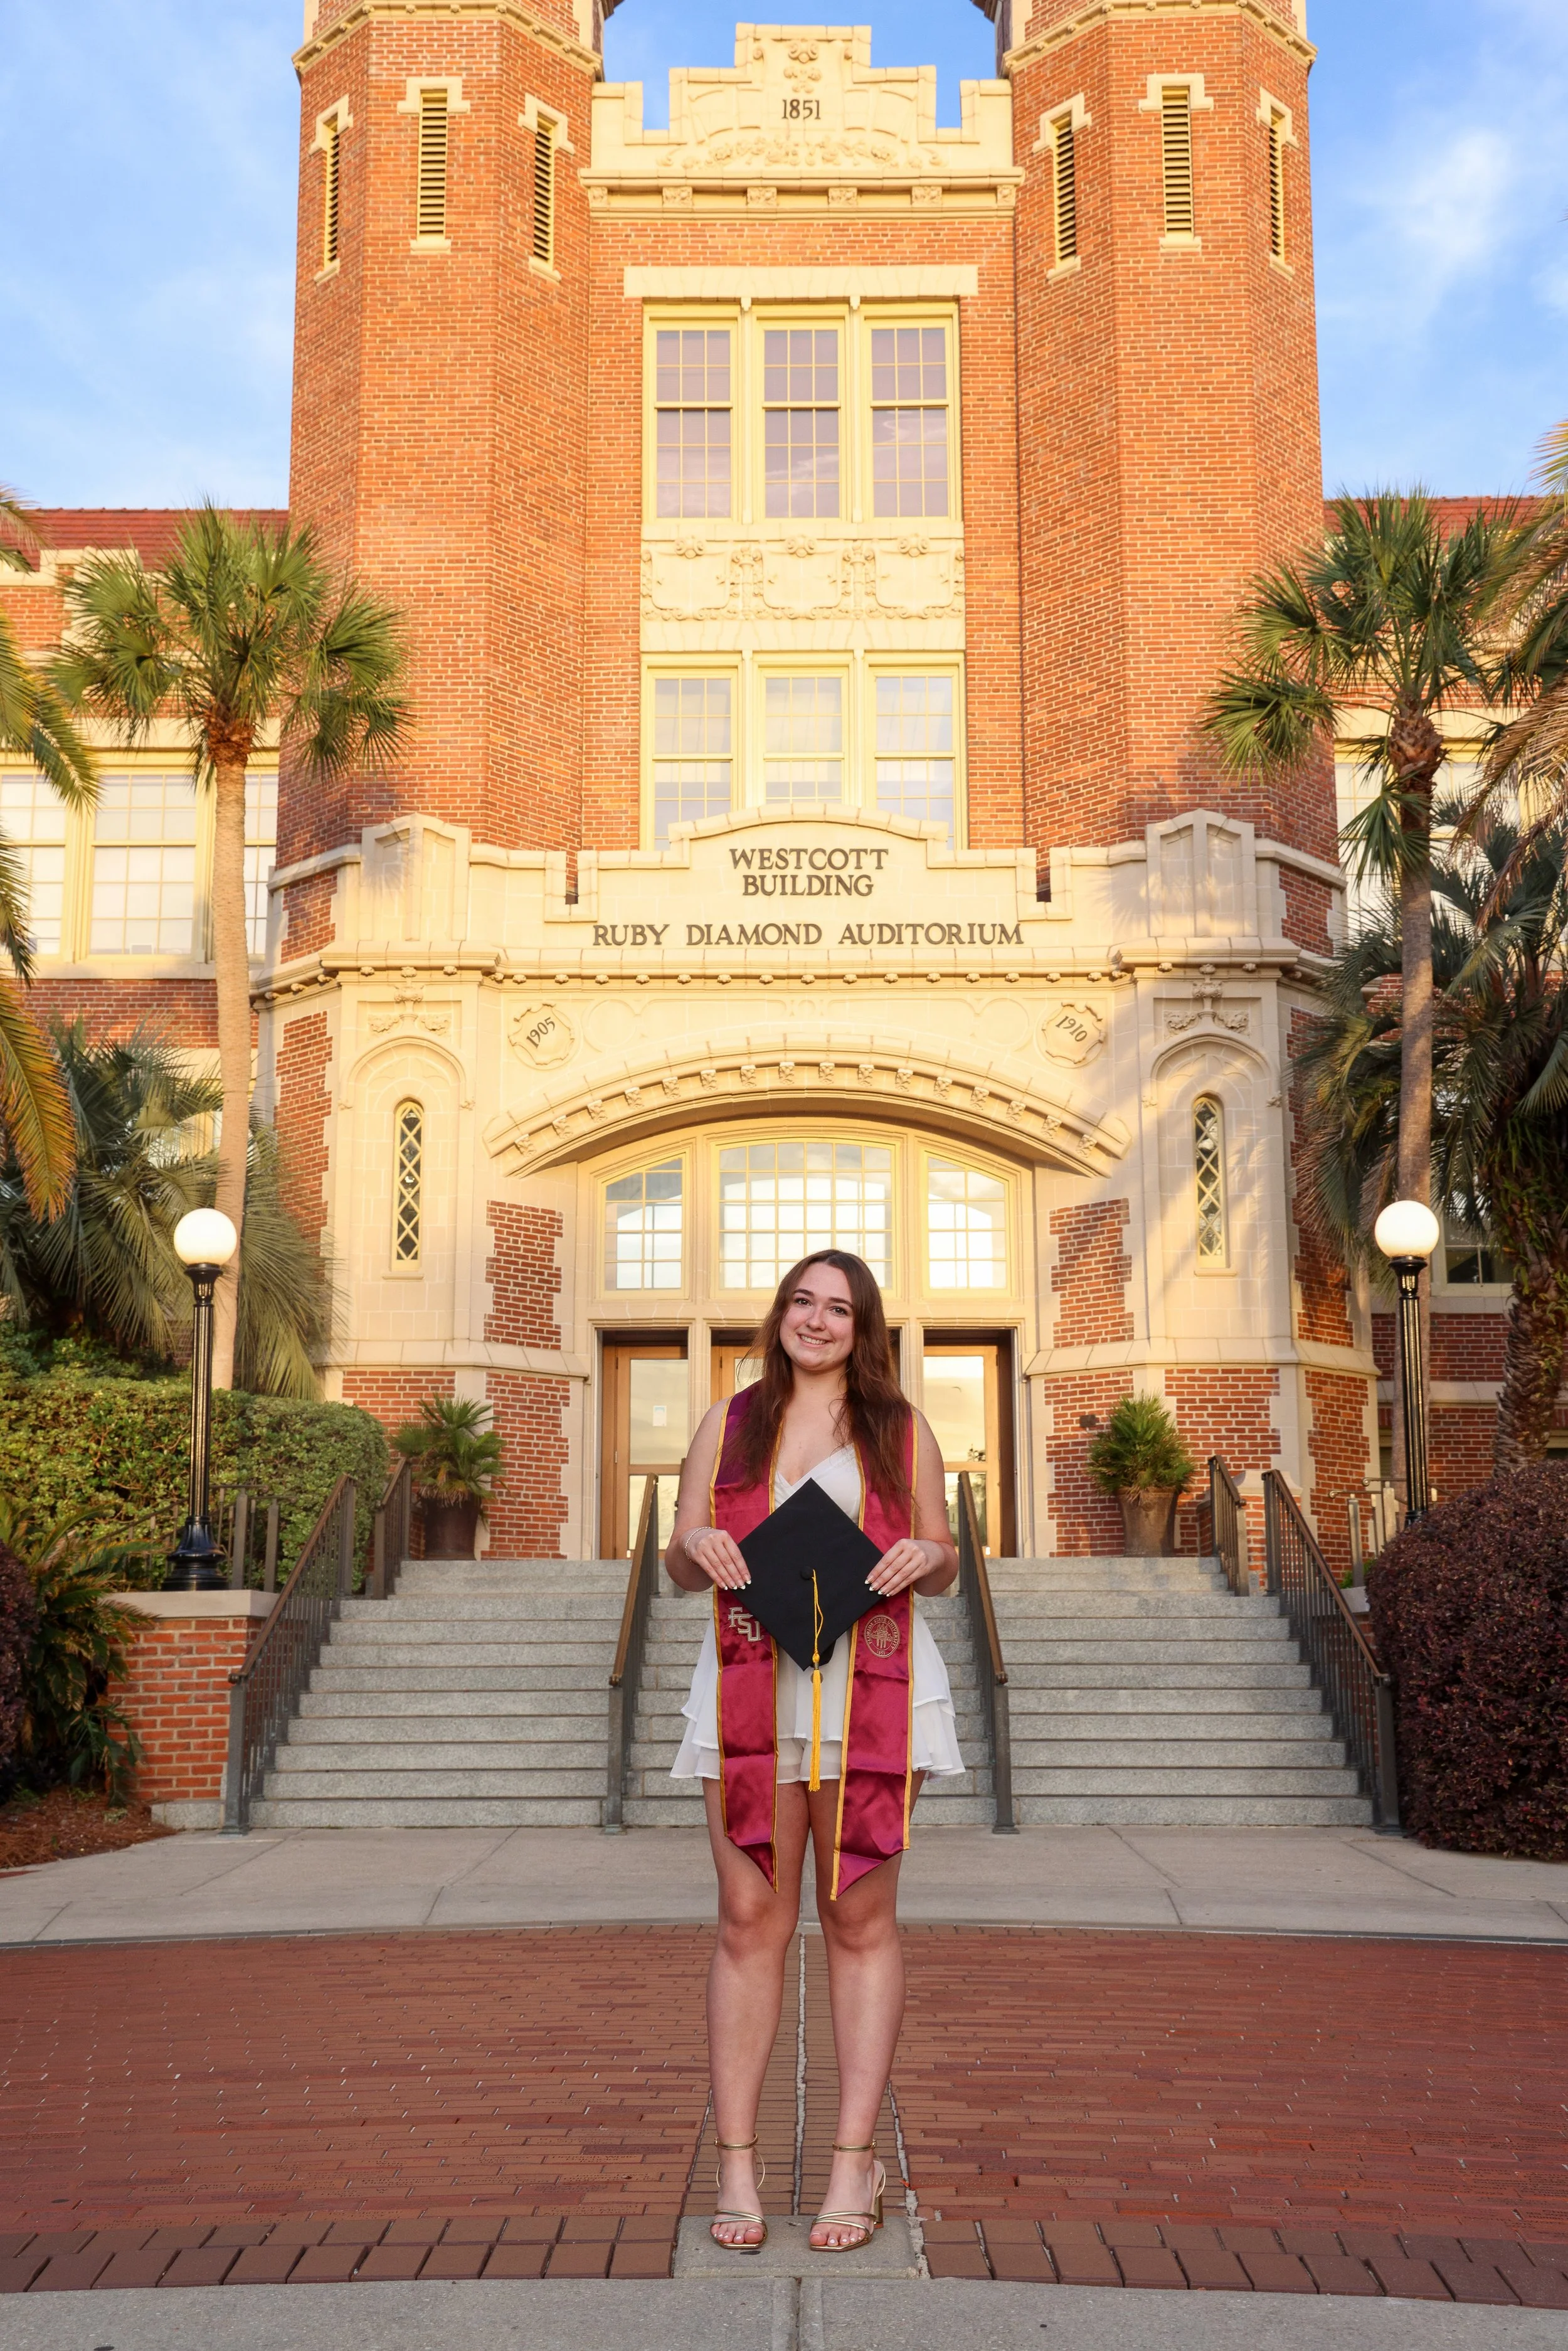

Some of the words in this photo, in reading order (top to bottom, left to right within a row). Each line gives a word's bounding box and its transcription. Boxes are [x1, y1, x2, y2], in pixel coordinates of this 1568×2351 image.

[781, 99, 821, 120] 1851
[729, 848, 889, 871] WESTCOTT
[743, 874, 874, 897] BUILDING
[593, 924, 670, 946] RUBY
[686, 923, 822, 946] DIAMOND
[838, 923, 1024, 945] AUDITORIUM
[526, 1017, 555, 1049] 1905
[1055, 1016, 1088, 1043] 1910
[728, 1606, 761, 1642] FSU
